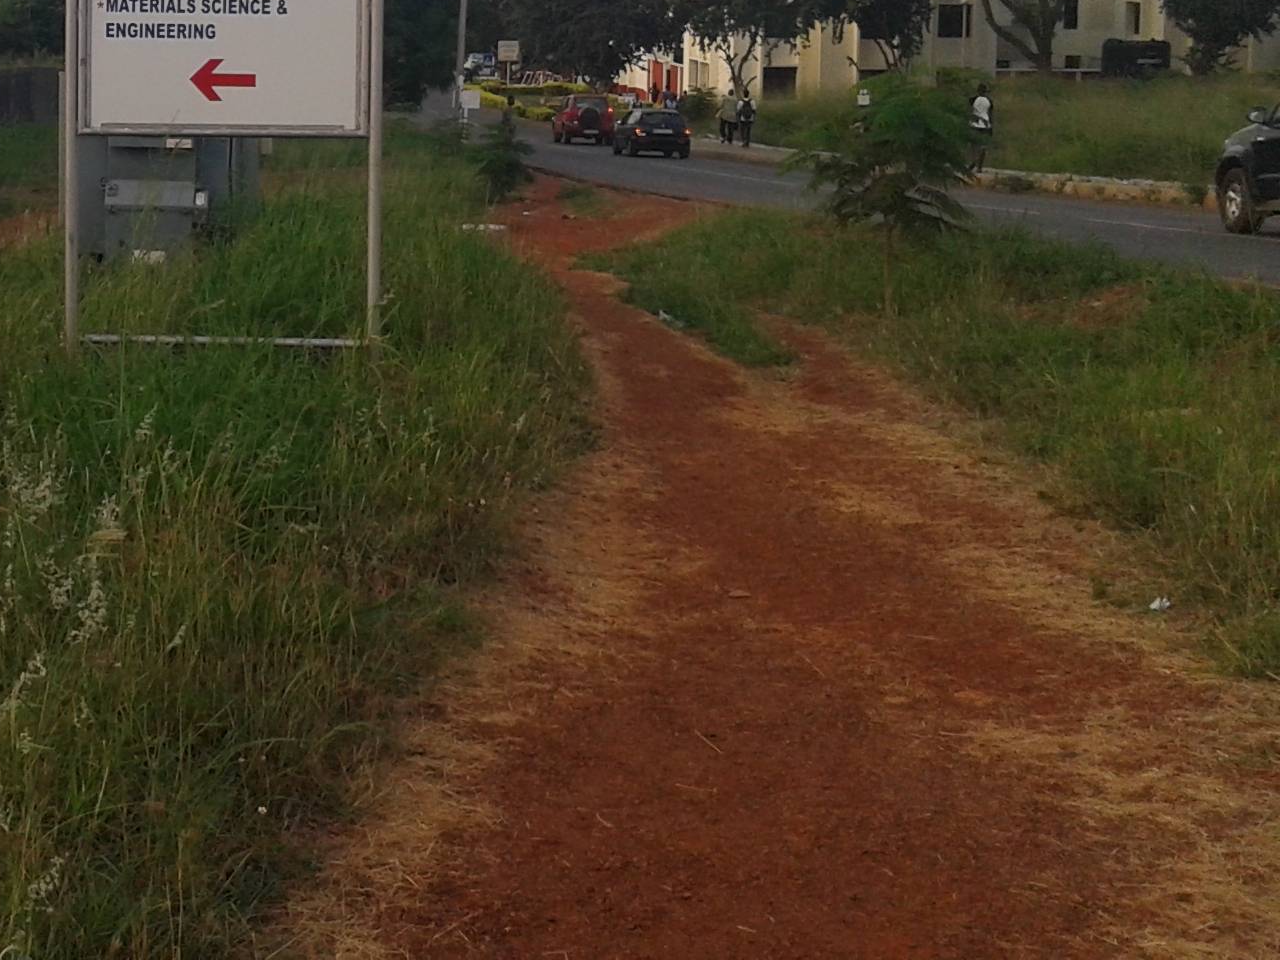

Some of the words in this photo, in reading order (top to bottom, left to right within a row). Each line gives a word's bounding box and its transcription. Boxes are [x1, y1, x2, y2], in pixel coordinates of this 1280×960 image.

[201, 0, 271, 14] SCIENCE
[276, 0, 288, 14] &
[106, 23, 216, 39] ENGINEERING
